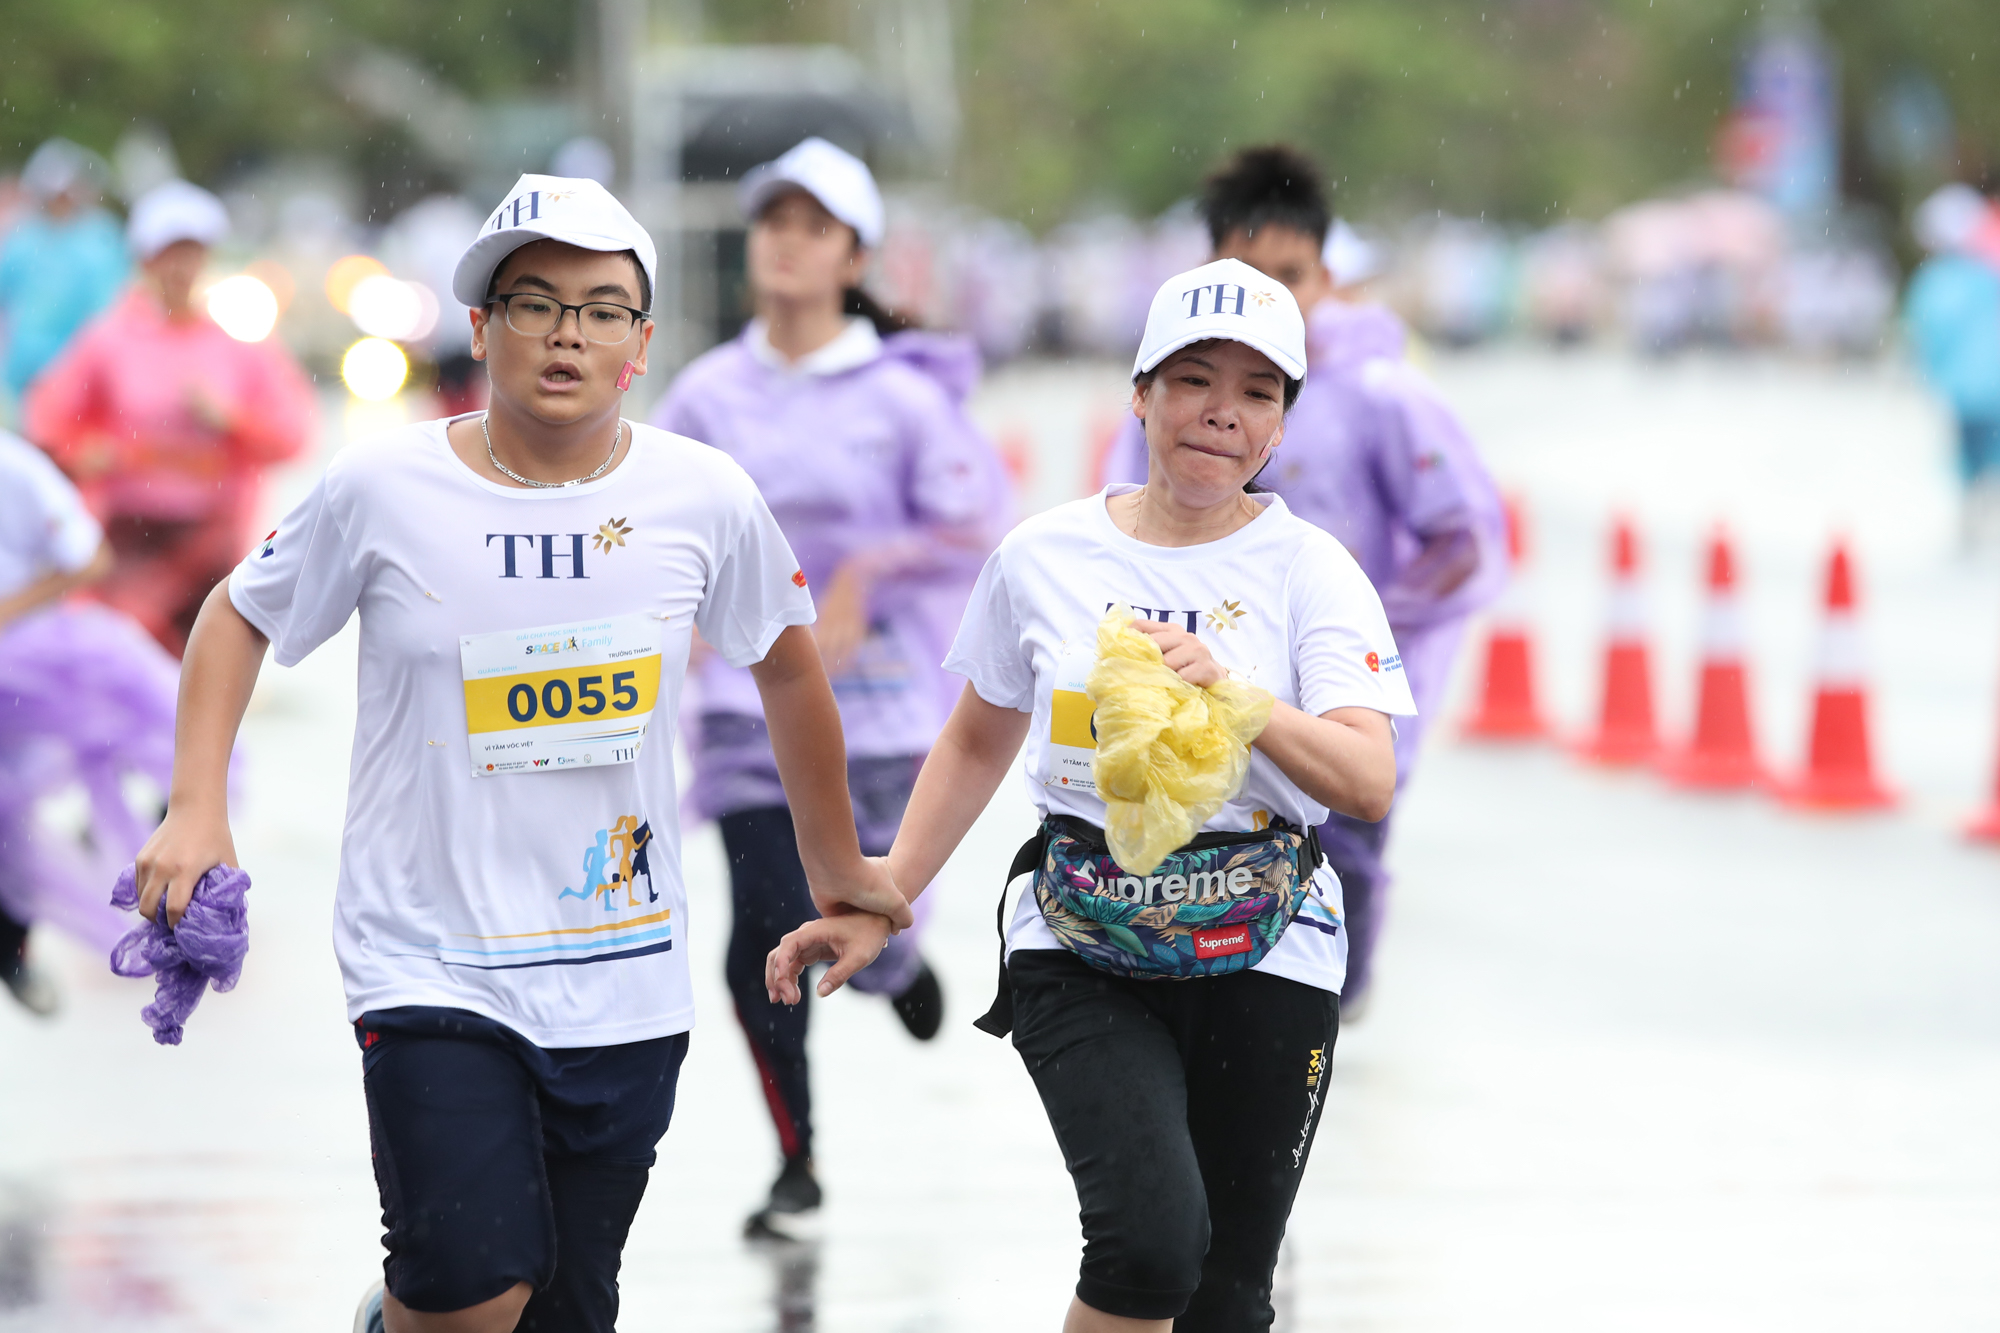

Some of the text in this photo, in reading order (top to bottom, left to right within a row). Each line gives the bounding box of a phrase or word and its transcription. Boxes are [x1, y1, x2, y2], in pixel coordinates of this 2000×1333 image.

[491, 190, 543, 230] TH
[1181, 283, 1248, 320] TH
[485, 533, 591, 579] TH
[563, 627, 578, 635] SINH
[582, 625, 597, 633] SINH
[581, 635, 613, 648] Family
[507, 670, 639, 722] 0055
[611, 746, 634, 762] TH
[532, 758, 550, 767] VTV
[1199, 934, 1245, 950] Supreme
